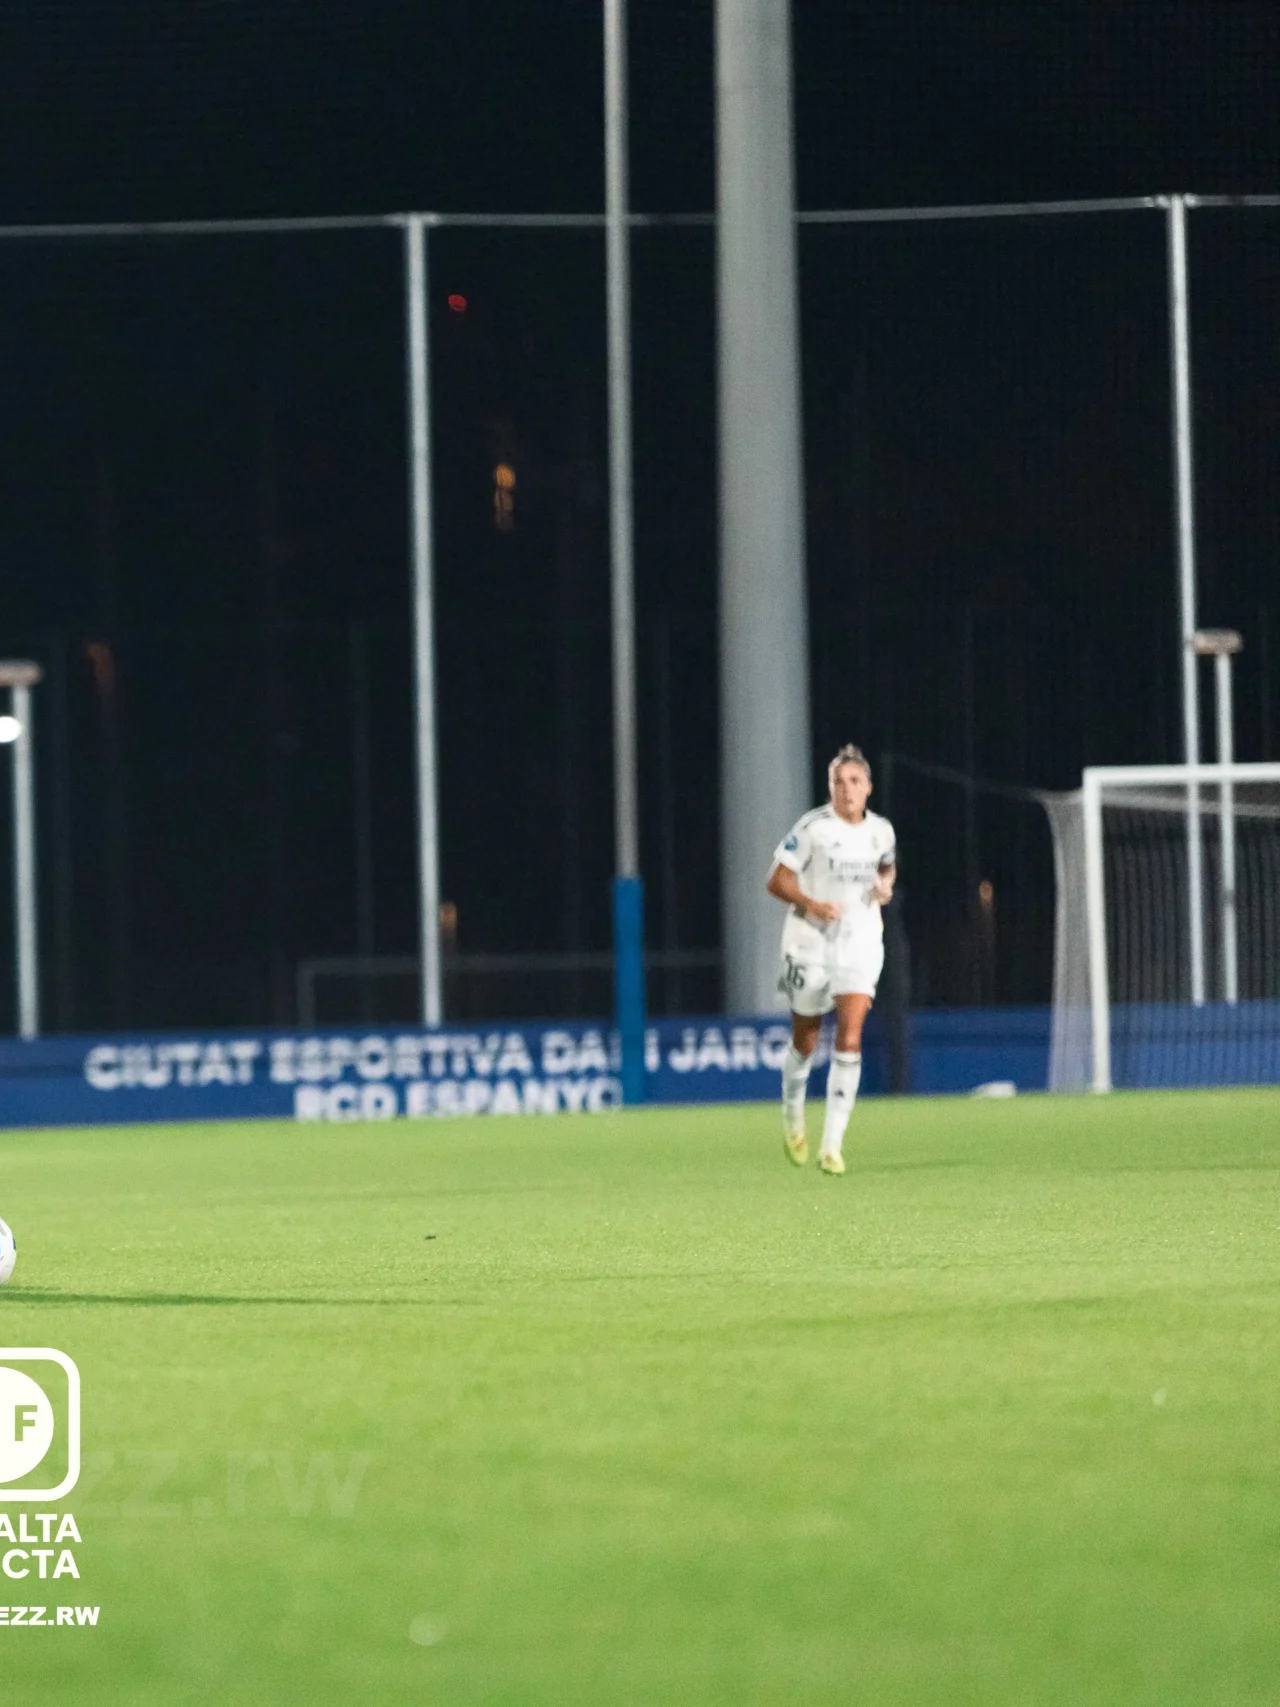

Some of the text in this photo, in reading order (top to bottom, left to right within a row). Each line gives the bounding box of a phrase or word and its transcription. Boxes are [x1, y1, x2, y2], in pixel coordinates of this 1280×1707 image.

[84, 1040, 261, 1089] CIUTAT
[269, 1033, 533, 1083] ESPORTIVA
[293, 1076, 624, 1121] RCD ESPANYO
